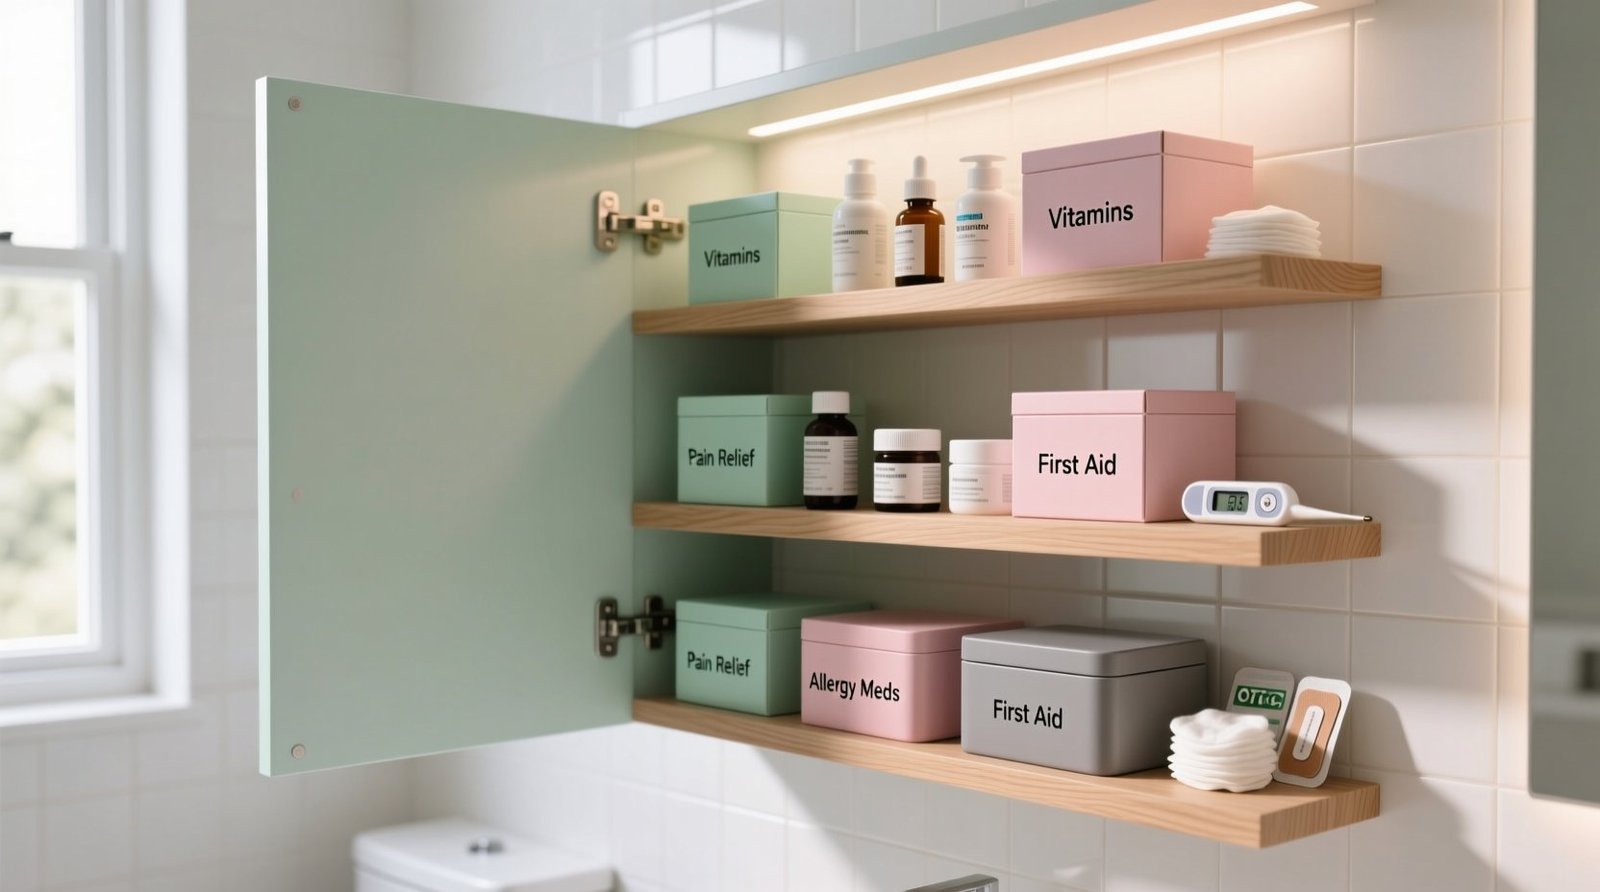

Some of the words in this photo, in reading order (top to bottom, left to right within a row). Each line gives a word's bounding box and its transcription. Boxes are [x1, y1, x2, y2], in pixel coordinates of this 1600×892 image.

[1048, 200, 1134, 230] Vitamins
[703, 246, 761, 268] Vitamins
[688, 448, 715, 467] Pain
[718, 448, 755, 468] Relief
[1038, 453, 1079, 475] First
[1084, 452, 1117, 476] Aid
[687, 651, 712, 671] Pain
[716, 656, 751, 677] Relief
[809, 671, 857, 701] Allergy
[861, 678, 900, 702] Meds
[993, 699, 1030, 724] First
[1033, 705, 1063, 729] Aid
